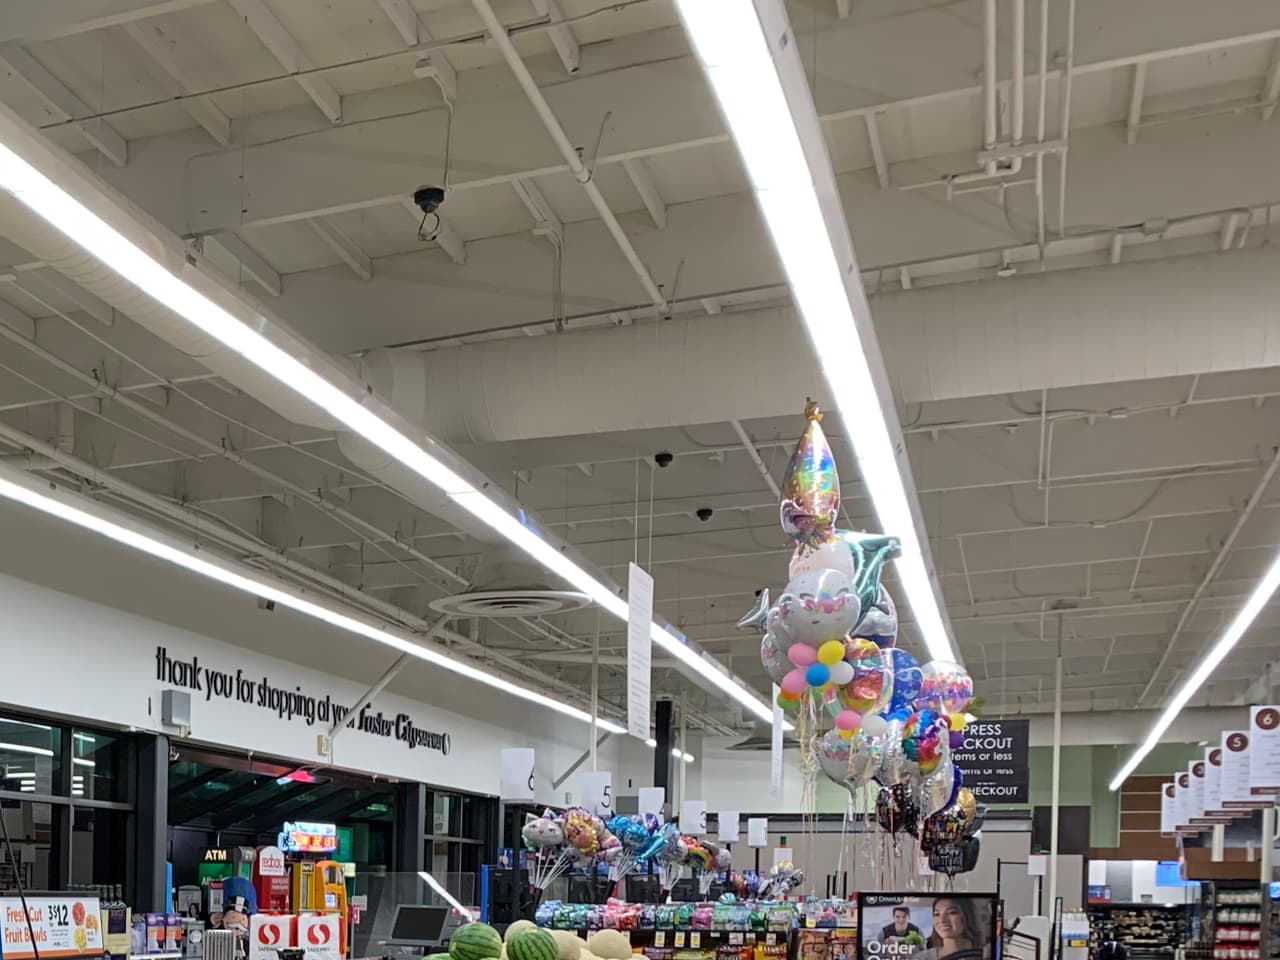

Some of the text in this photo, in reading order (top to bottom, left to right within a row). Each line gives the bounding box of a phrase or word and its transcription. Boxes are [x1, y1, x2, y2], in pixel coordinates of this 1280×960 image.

[155, 646, 202, 691] thank
[205, 668, 233, 701] you
[236, 669, 256, 704] for
[257, 677, 315, 726] shopping
[318, 695, 330, 722] at
[395, 713, 419, 749] City
[1263, 713, 1273, 725] 6
[961, 724, 1002, 736] PRESS
[960, 737, 1013, 750] CKOUT
[1233, 737, 1241, 747] 5
[979, 753, 990, 761] or
[993, 751, 1013, 761] less
[601, 785, 611, 808] 5
[968, 786, 1018, 796] HECKOUT
[204, 849, 227, 861] ATM
[28, 906, 43, 922] Cut
[4, 927, 24, 944] Fruit
[24, 926, 48, 943] Bwls
[866, 940, 916, 955] Order
